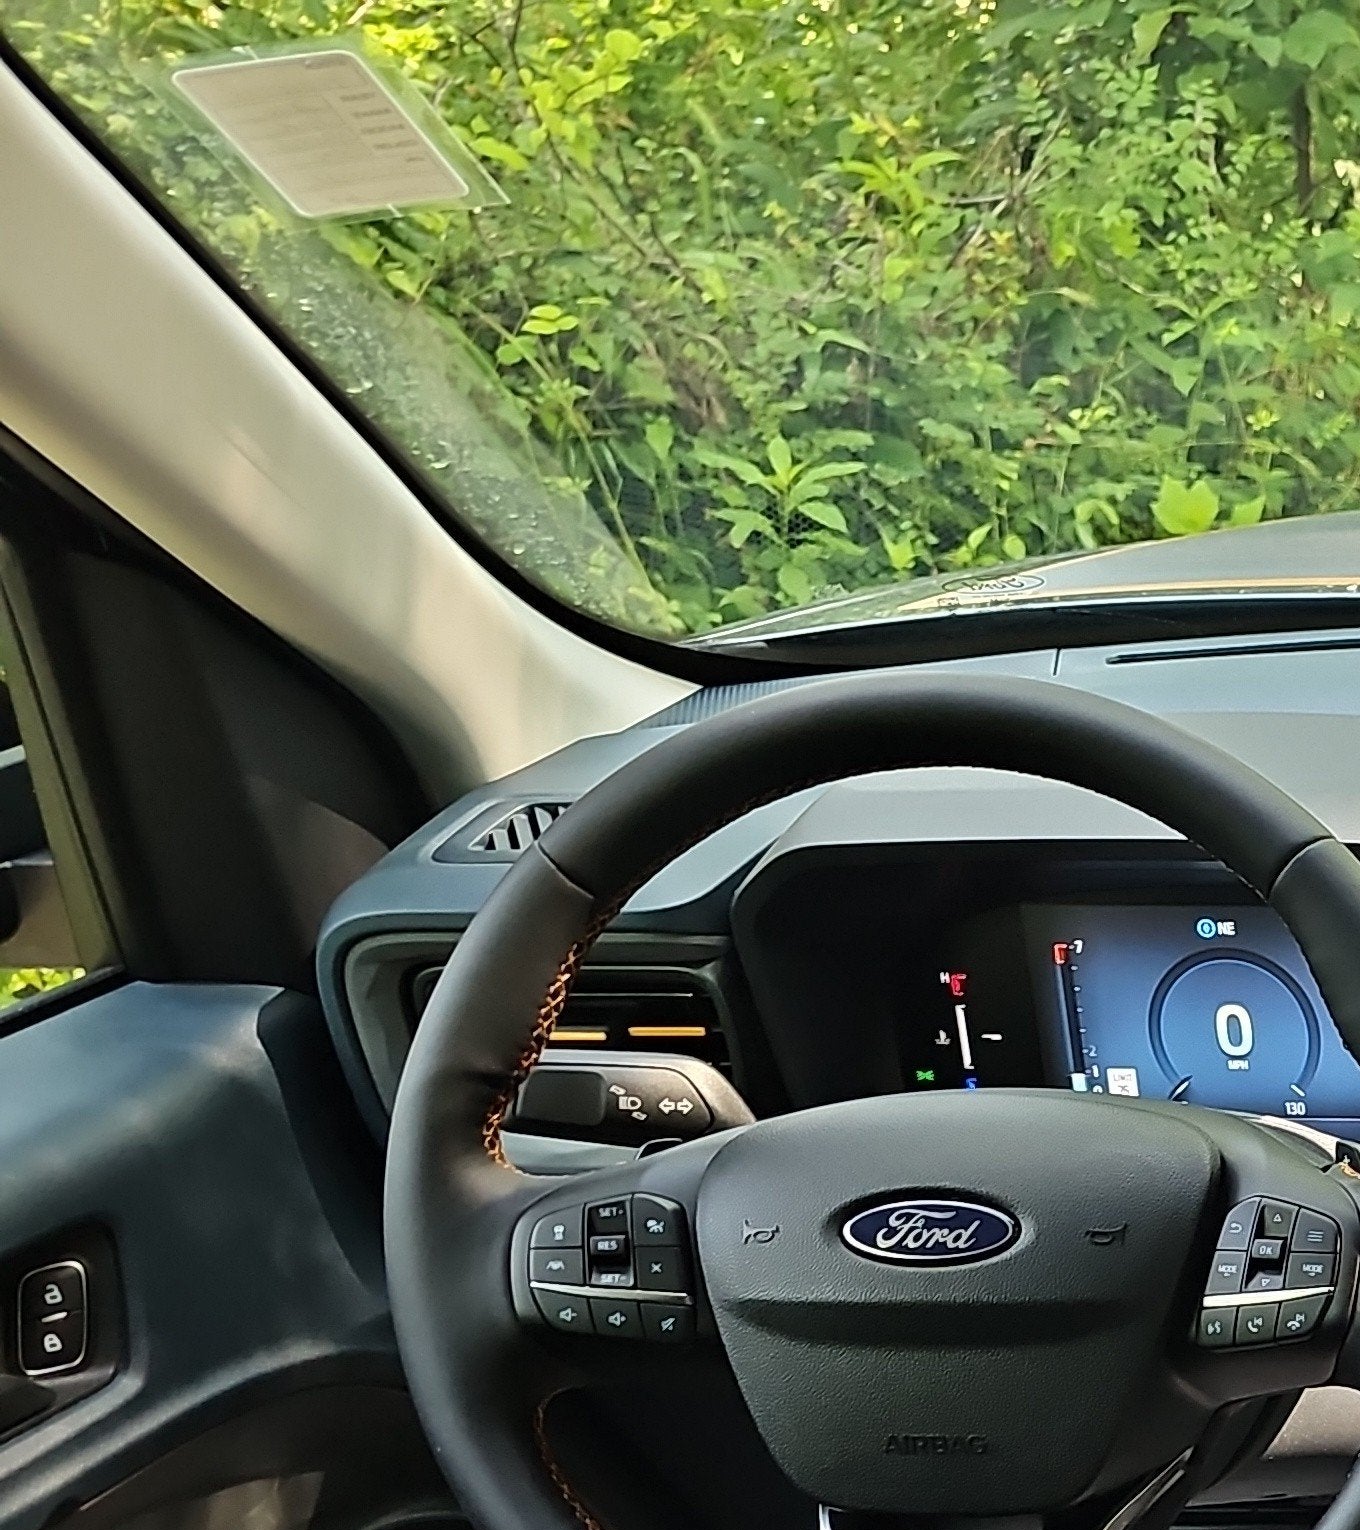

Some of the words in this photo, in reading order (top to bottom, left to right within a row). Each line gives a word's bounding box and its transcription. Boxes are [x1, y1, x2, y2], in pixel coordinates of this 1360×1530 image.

[1217, 922, 1236, 936] NE
[1215, 1004, 1254, 1057] 0
[1228, 1060, 1249, 1070] MPH
[1285, 1102, 1306, 1116] 130
[876, 1209, 981, 1249] Ford
[1260, 1246, 1273, 1255] OK
[1218, 1265, 1238, 1273] MODE
[1303, 1264, 1324, 1273] MODE
[881, 1433, 987, 1456] AIRBAG
